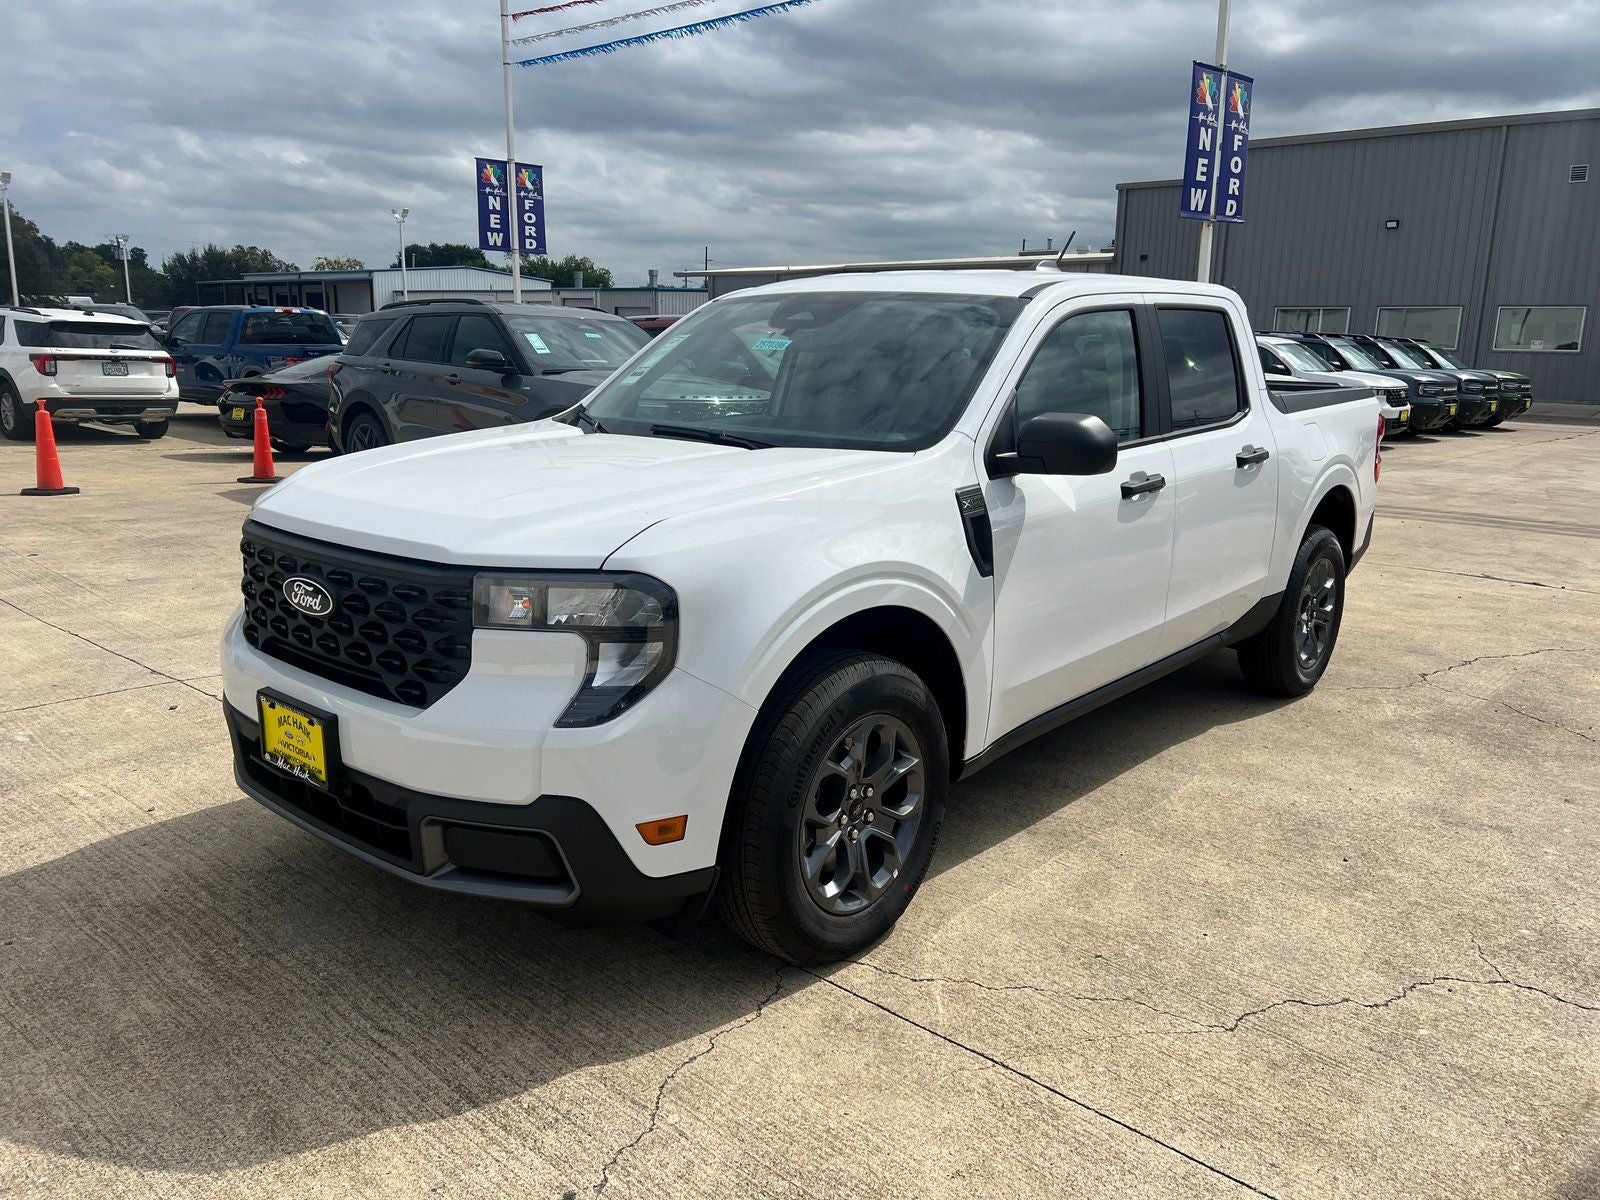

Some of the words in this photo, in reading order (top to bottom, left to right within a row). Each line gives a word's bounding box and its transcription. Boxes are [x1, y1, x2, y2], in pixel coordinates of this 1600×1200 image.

[1190, 127, 1212, 211] NEW
[1225, 134, 1243, 216] FORD
[487, 196, 503, 246] NEW
[523, 199, 537, 250] FORD
[291, 581, 322, 611] Ford
[277, 756, 291, 769] Mac
